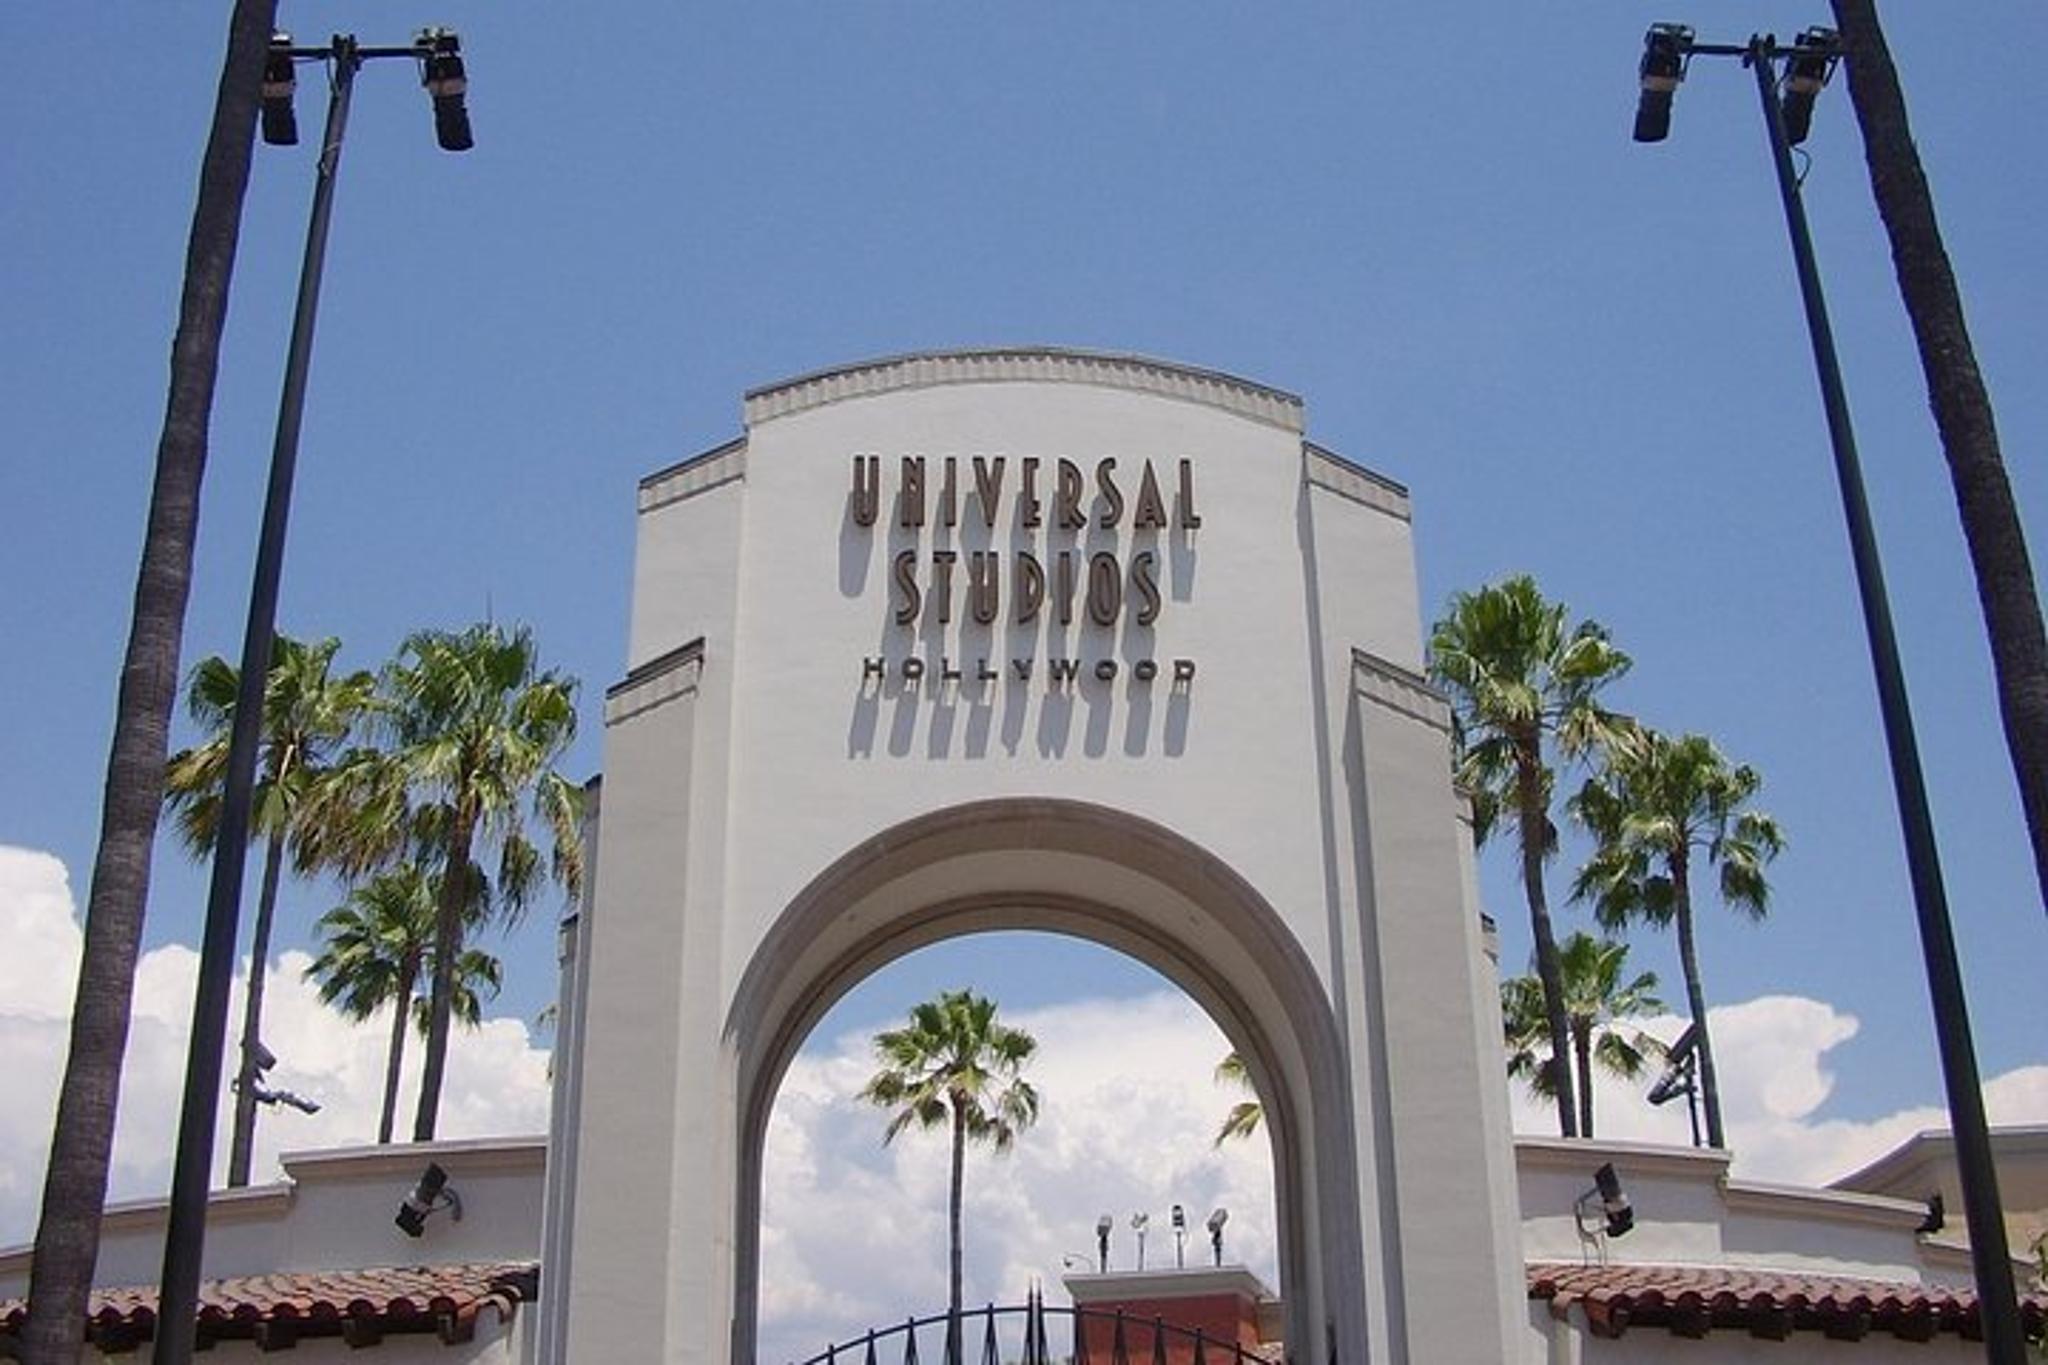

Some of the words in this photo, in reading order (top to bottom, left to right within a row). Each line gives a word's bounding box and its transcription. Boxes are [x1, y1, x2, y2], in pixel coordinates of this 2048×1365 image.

[853, 456, 1201, 529] UNIVERSAL
[895, 550, 1162, 626] STUDIOS
[863, 657, 1196, 681] HOLLYWOOD
